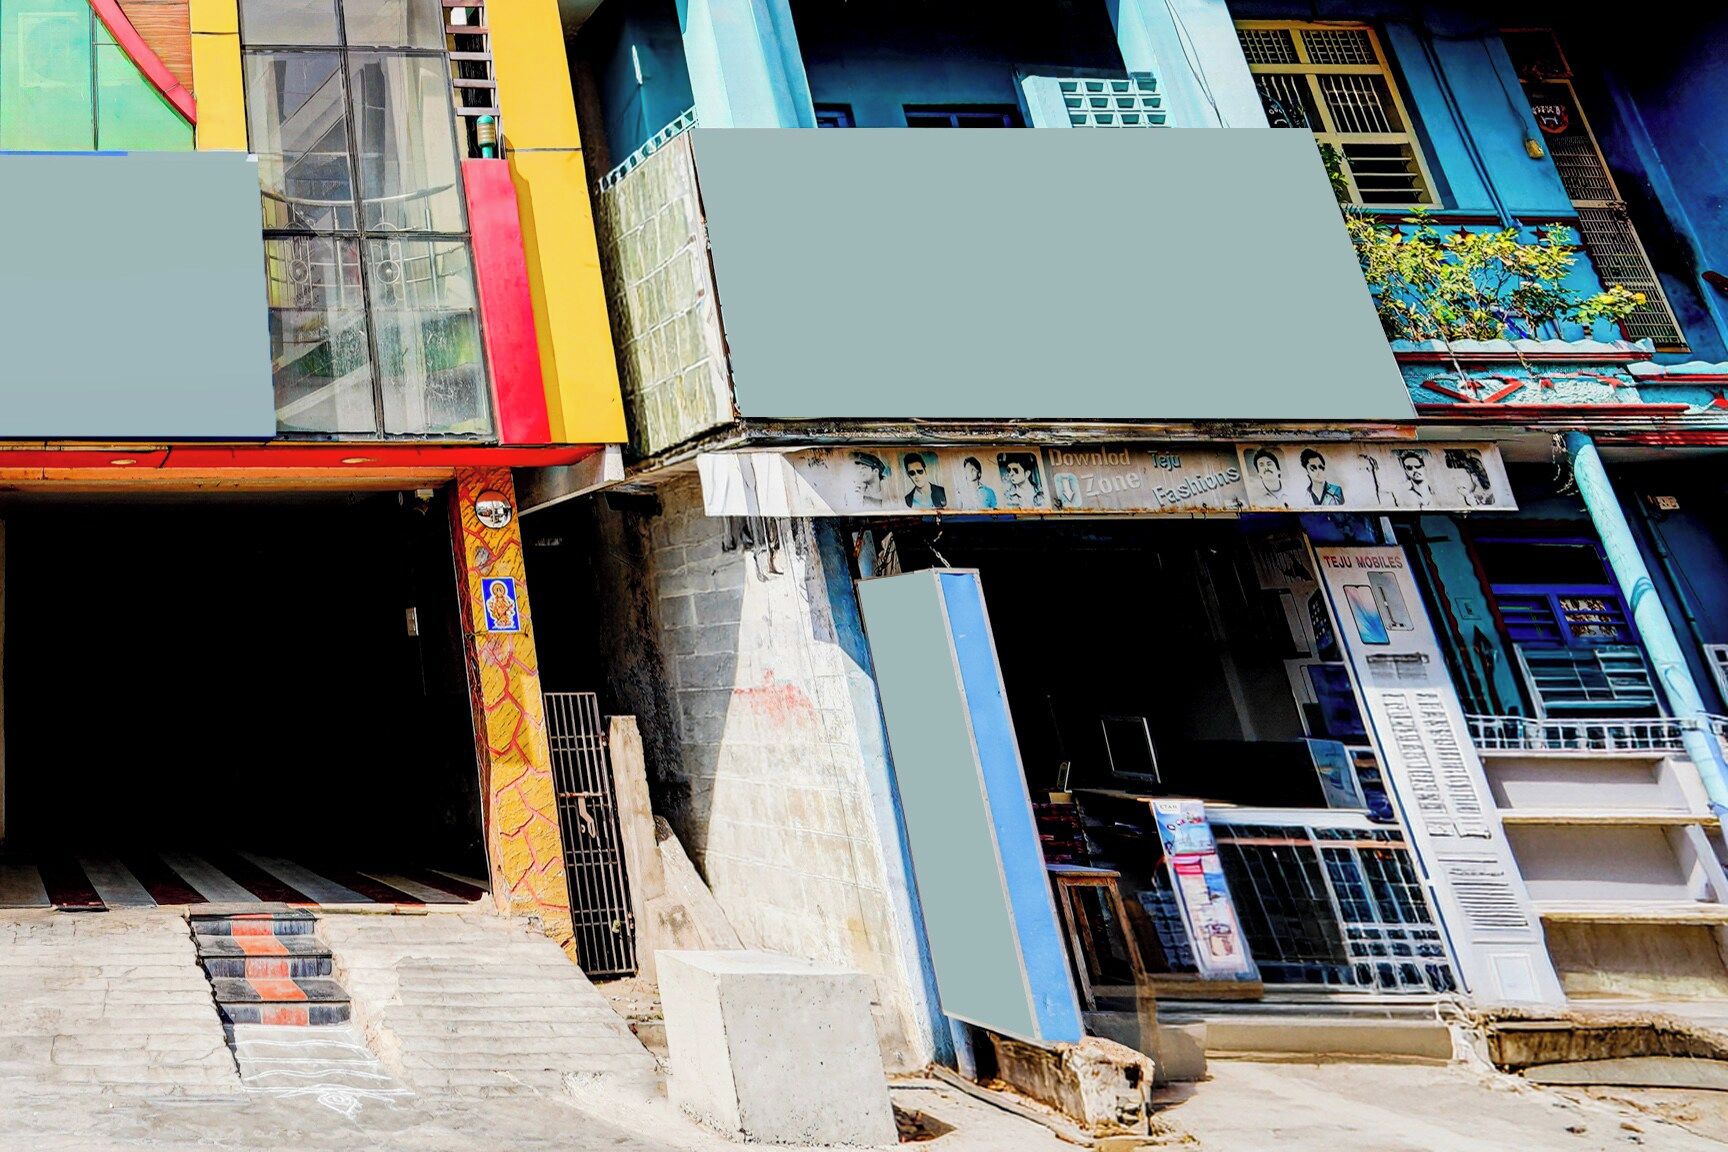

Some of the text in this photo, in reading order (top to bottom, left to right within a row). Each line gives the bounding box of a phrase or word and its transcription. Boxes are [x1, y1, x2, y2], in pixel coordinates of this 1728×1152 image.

[1148, 451, 1181, 471] Teju
[1080, 471, 1141, 497] Zone
[1152, 466, 1241, 507] Fashions
[1324, 555, 1403, 568] TEJU MOBILES
